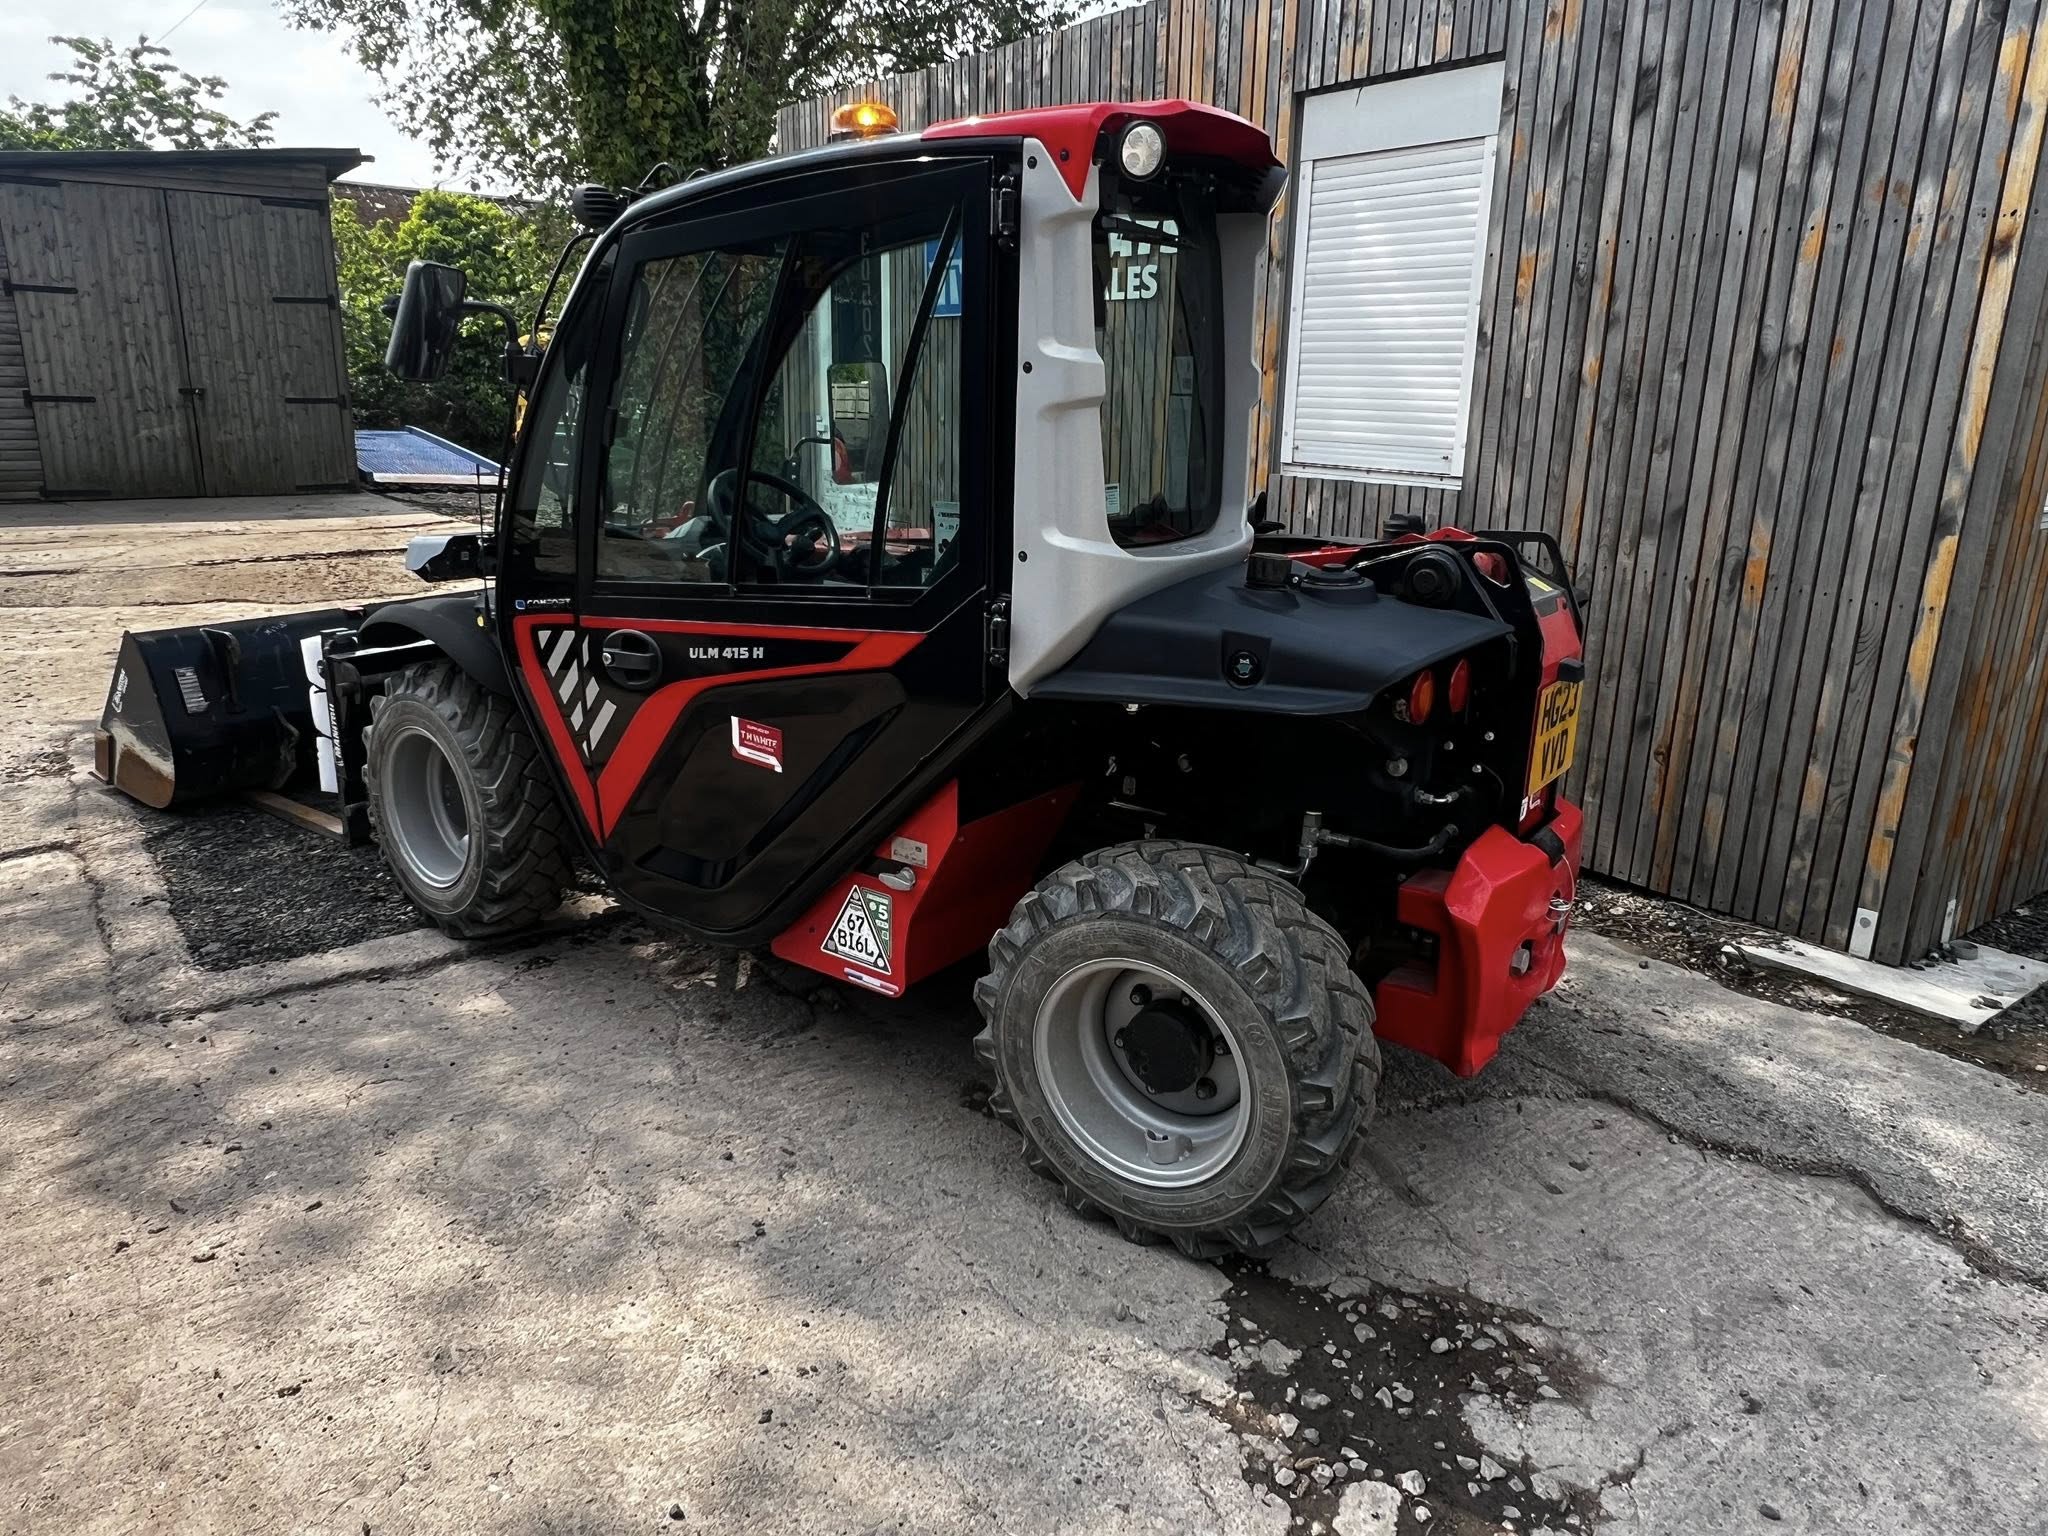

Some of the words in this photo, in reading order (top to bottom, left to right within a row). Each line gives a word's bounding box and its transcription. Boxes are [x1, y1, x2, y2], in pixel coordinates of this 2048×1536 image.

[689, 647, 719, 659] ULM
[722, 647, 749, 659] 415
[752, 647, 764, 659] H
[847, 913, 865, 933] 67
